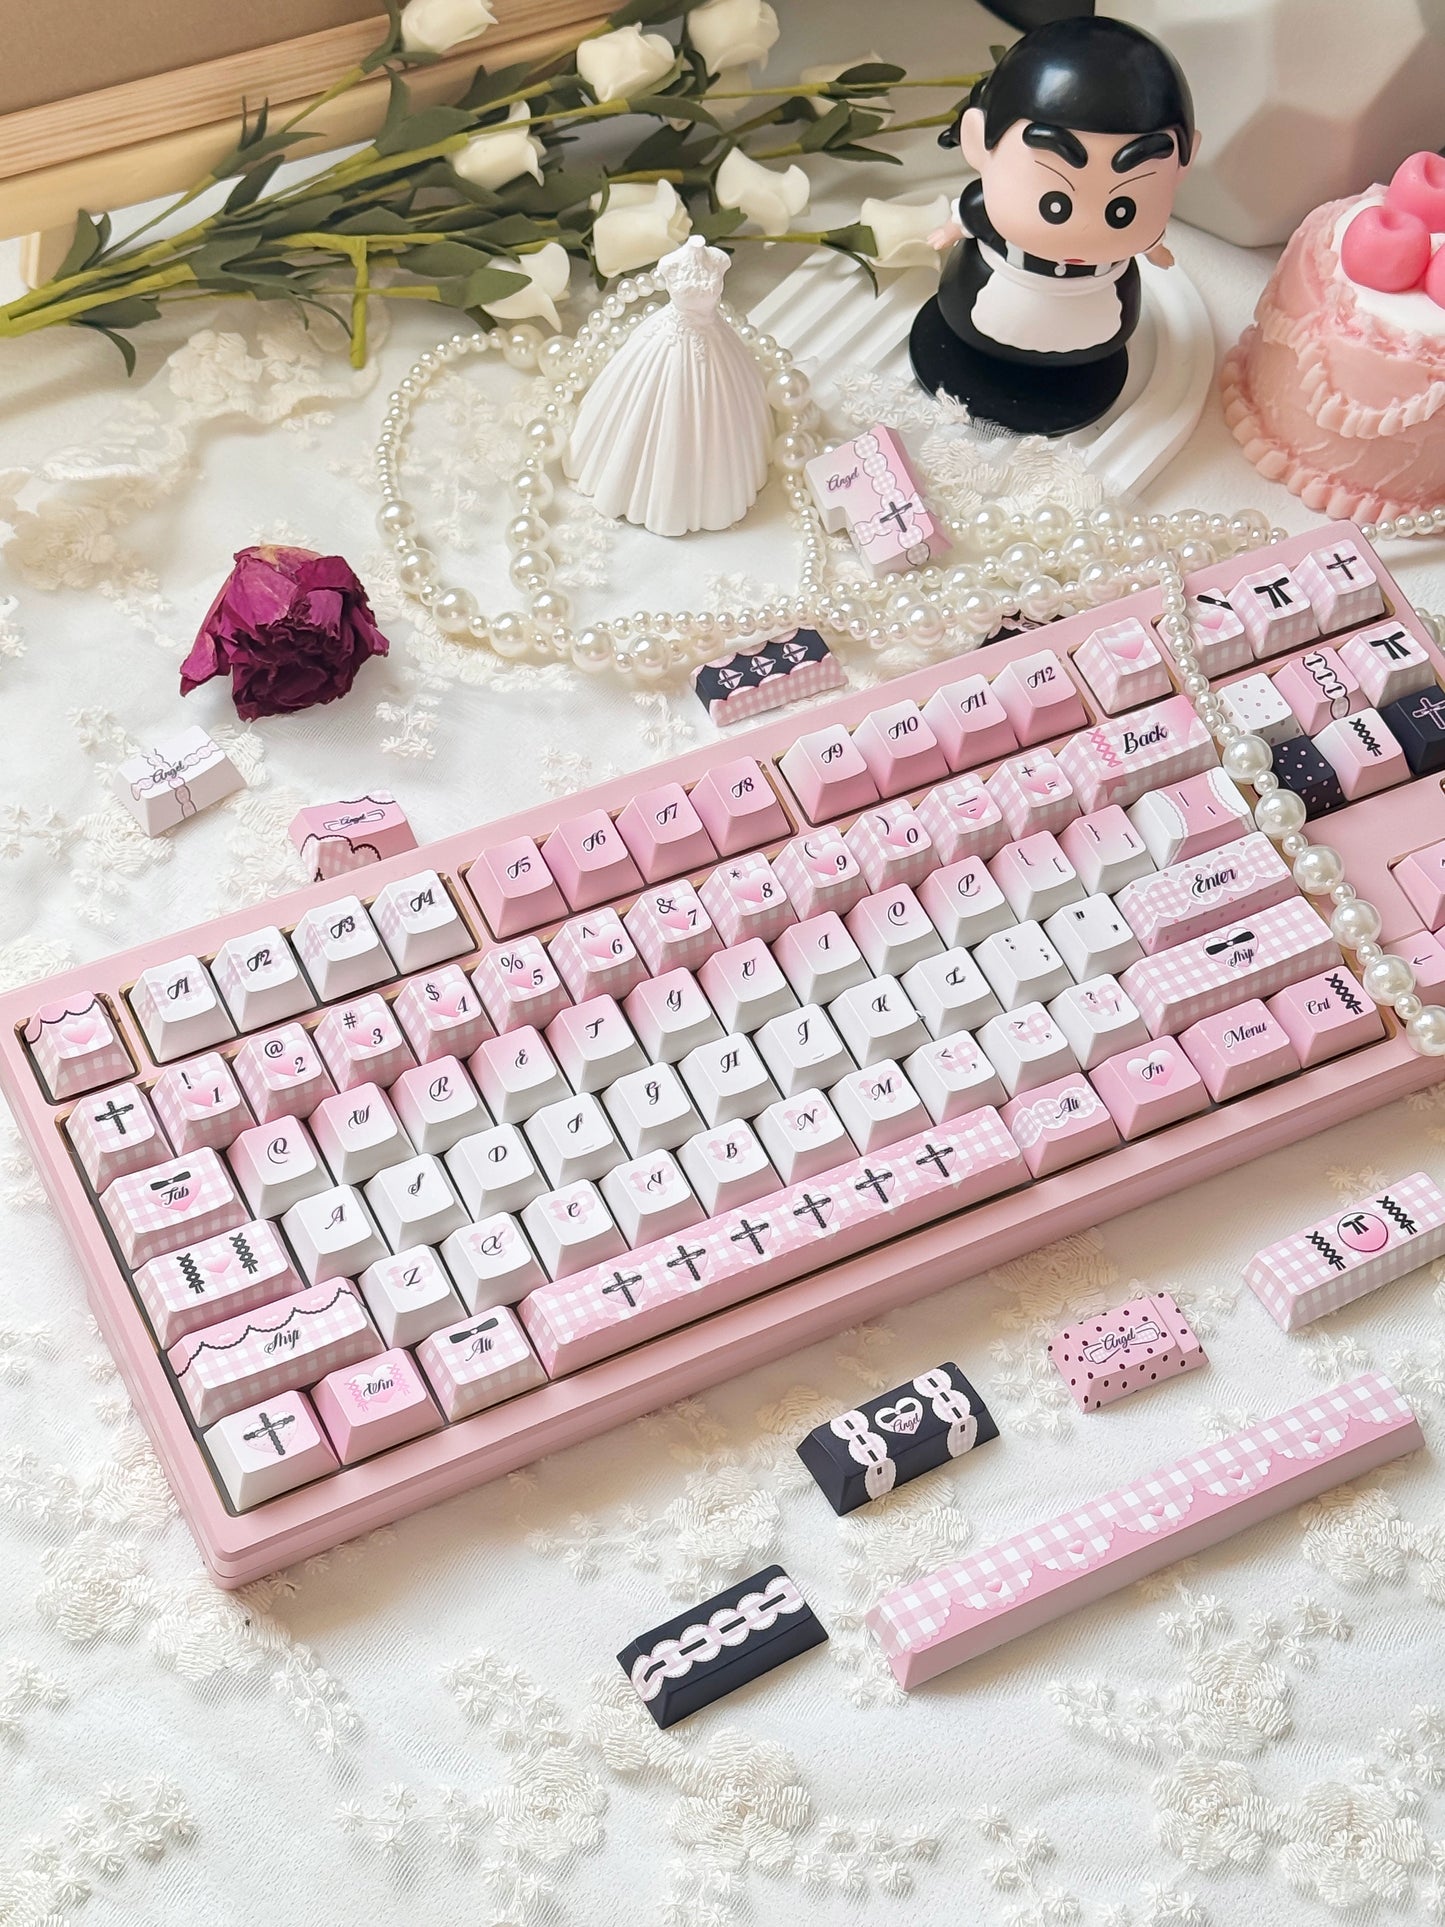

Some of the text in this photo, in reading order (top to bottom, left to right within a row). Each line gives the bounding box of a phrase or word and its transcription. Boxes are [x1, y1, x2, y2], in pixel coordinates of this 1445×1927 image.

[826, 467, 859, 491] Angel
[1028, 667, 1056, 688] F12
[960, 691, 988, 714] F11
[888, 717, 918, 740] F10
[1123, 723, 1168, 754] Back
[820, 743, 843, 764] F9
[150, 760, 185, 785] Angel
[1021, 766, 1034, 777] +
[731, 777, 754, 798] F8
[655, 802, 678, 825] F7
[876, 815, 889, 835] )
[906, 827, 918, 843] 0
[1087, 823, 1100, 842] }
[582, 829, 606, 852] F6
[804, 842, 817, 860] (
[1123, 833, 1136, 848] ]
[507, 856, 531, 879] F5
[836, 854, 847, 871] 9
[1018, 848, 1034, 866] {
[1053, 857, 1066, 872] [
[762, 883, 773, 898] 8
[958, 873, 981, 897] P
[1192, 869, 1236, 898] Enter
[410, 888, 435, 912] F4
[656, 898, 677, 914] &
[687, 909, 697, 926] 7
[887, 901, 909, 926] O
[330, 915, 356, 939] F3
[612, 939, 622, 954] 6
[818, 932, 829, 951] I
[247, 949, 272, 972] F2
[501, 954, 523, 973] %
[742, 958, 757, 980] U
[532, 969, 543, 985] 5
[945, 967, 966, 986] L
[167, 976, 190, 1000] F1
[425, 983, 440, 1002] $
[1086, 992, 1097, 1003] ?
[457, 996, 469, 1014] 4
[666, 988, 683, 1012] Y
[871, 994, 890, 1013] K
[343, 1012, 357, 1029] #
[585, 1018, 604, 1039] T
[1014, 1021, 1025, 1029] >
[373, 1028, 383, 1044] 3
[797, 1018, 810, 1045] J
[1223, 1021, 1267, 1047] Menu
[265, 1041, 283, 1058] @
[515, 1049, 528, 1069] E
[940, 1049, 953, 1059] <
[295, 1057, 306, 1073] 2
[720, 1049, 740, 1073] H
[181, 1072, 192, 1089] !
[1142, 1062, 1164, 1082] Fn
[213, 1087, 222, 1103] 1
[429, 1076, 454, 1101] R
[645, 1081, 661, 1105] G
[871, 1079, 892, 1100] M
[348, 1105, 370, 1129] W
[1055, 1096, 1079, 1119] Alt
[567, 1113, 583, 1133] F
[797, 1109, 818, 1130] N
[267, 1137, 291, 1164] Q
[488, 1146, 507, 1162] D
[726, 1143, 738, 1159] B
[408, 1172, 424, 1196] S
[647, 1170, 662, 1192] V
[161, 1186, 190, 1206] Tab
[325, 1204, 345, 1230] A
[567, 1202, 580, 1217] C
[481, 1230, 505, 1256] X
[403, 1267, 421, 1288] Z
[465, 1337, 494, 1362] Alt
[1102, 1327, 1136, 1351] Angel
[362, 1376, 395, 1398] Win
[892, 1413, 920, 1432] Angel
